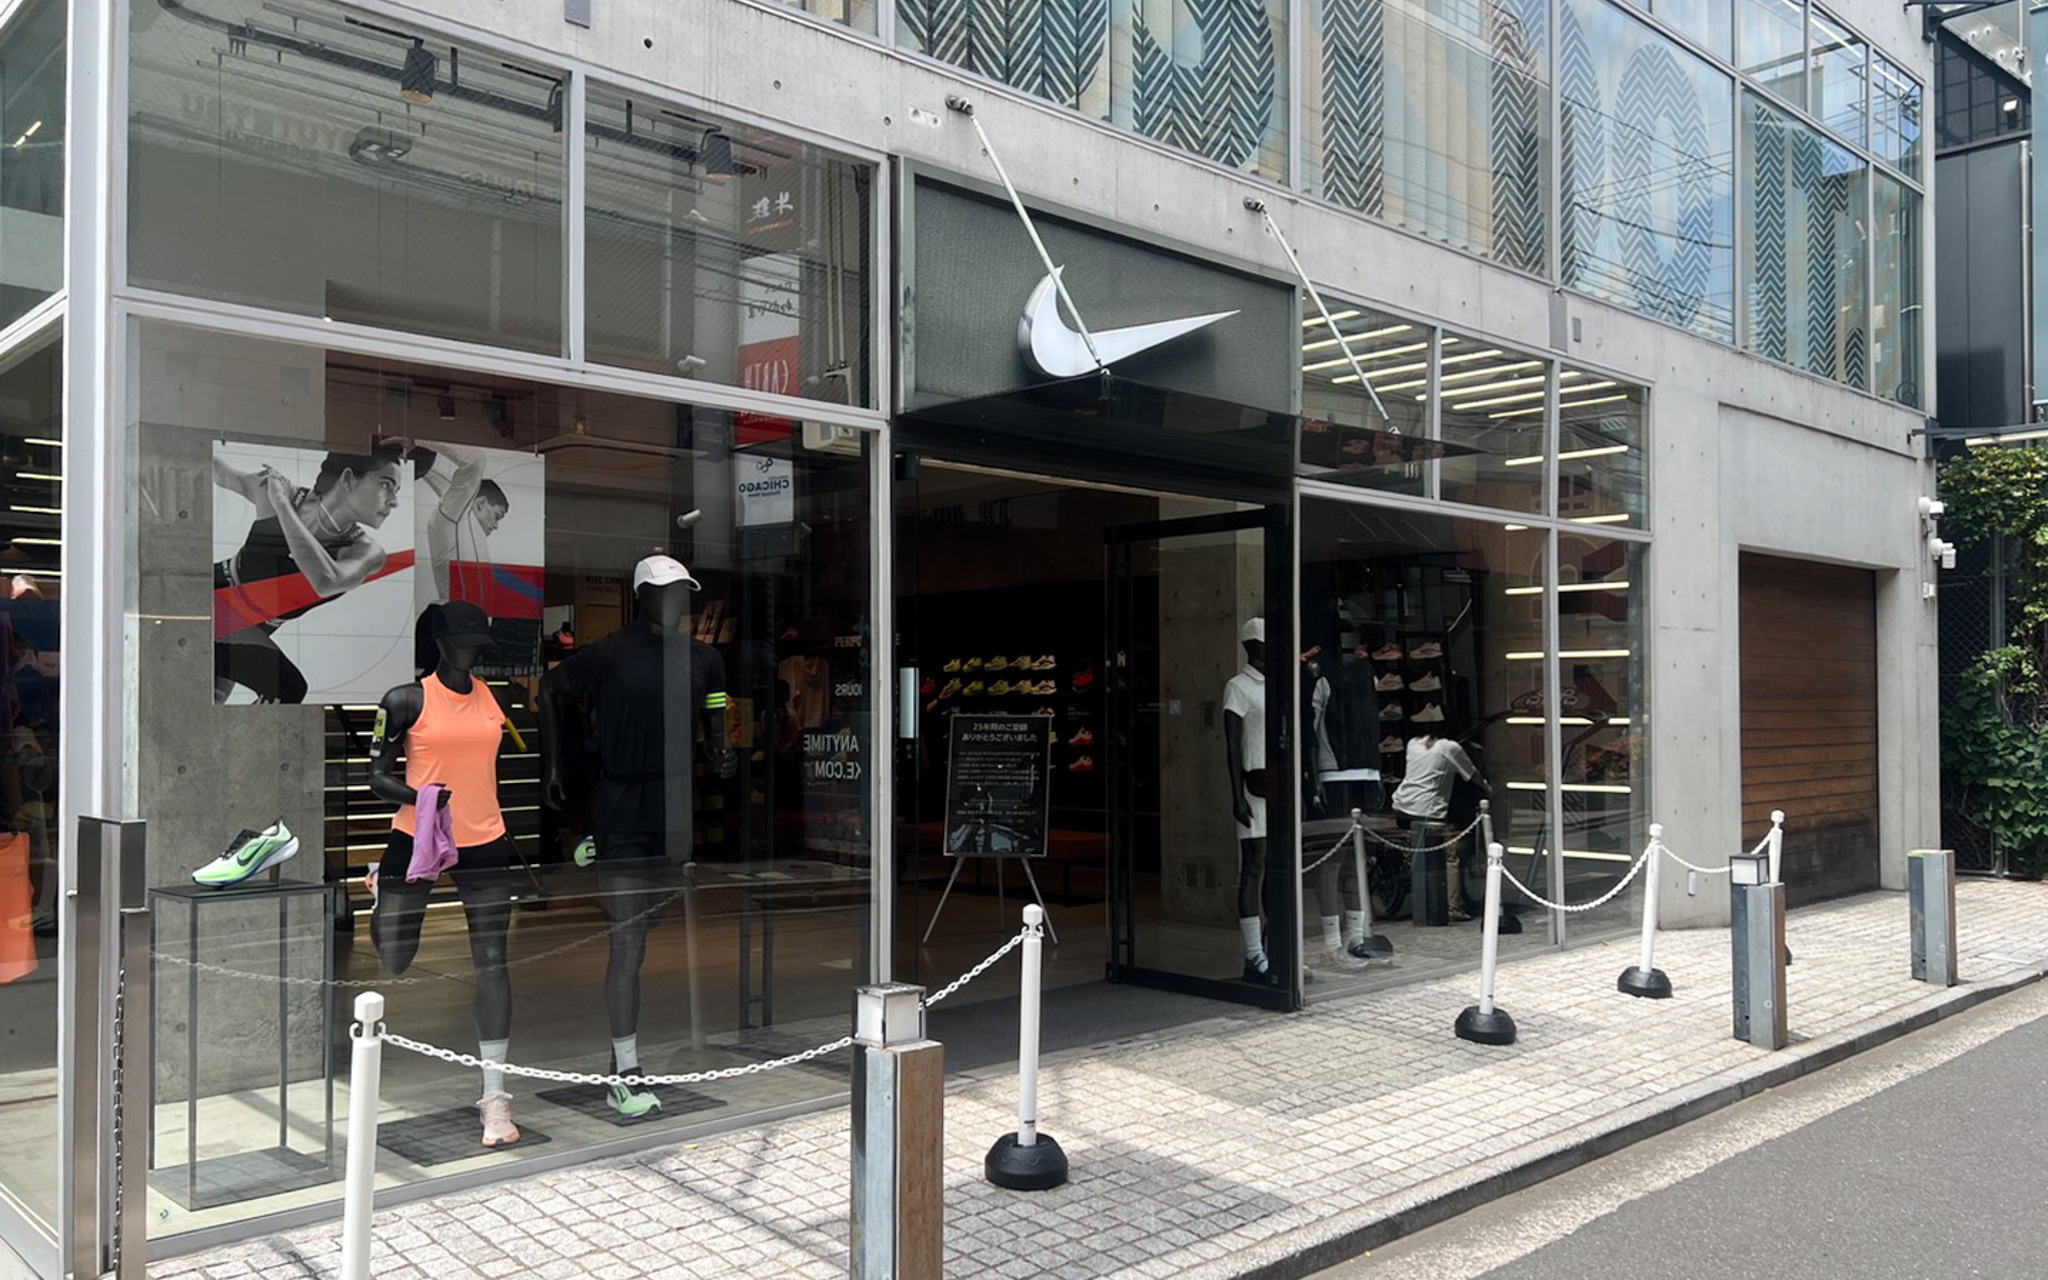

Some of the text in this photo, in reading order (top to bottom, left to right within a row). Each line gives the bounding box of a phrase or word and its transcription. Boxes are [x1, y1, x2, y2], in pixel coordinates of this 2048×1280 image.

[961, 732, 1038, 742] ありがとうございました
